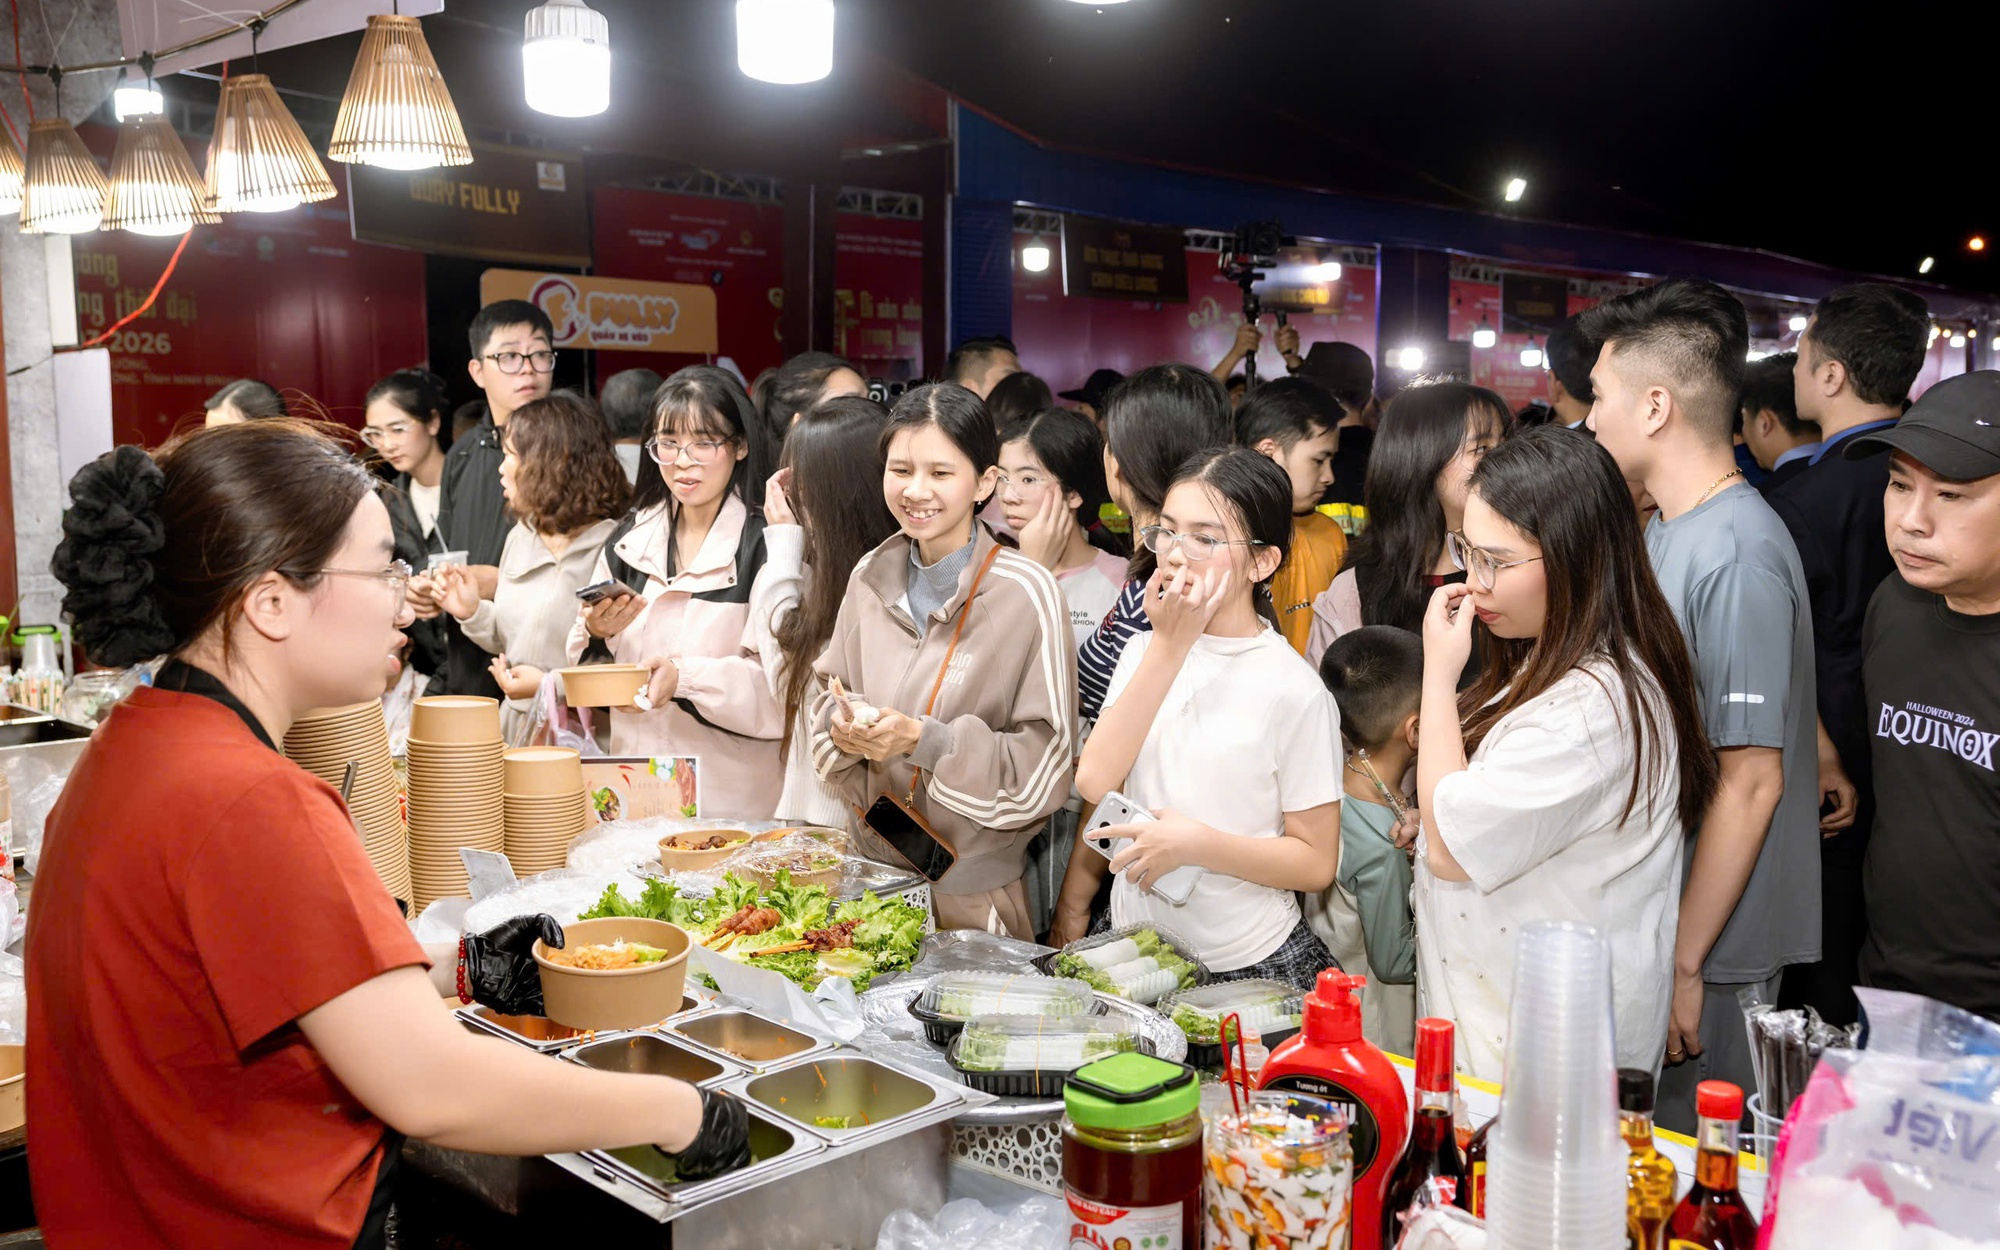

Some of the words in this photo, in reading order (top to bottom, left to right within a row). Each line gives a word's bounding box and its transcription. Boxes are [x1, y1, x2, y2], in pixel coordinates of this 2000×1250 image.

[460, 183, 520, 214] FULLY
[1906, 701, 1954, 720] HALLOWEEN
[1955, 713, 1975, 726] 2024
[1876, 702, 2000, 771] EQUINOX
